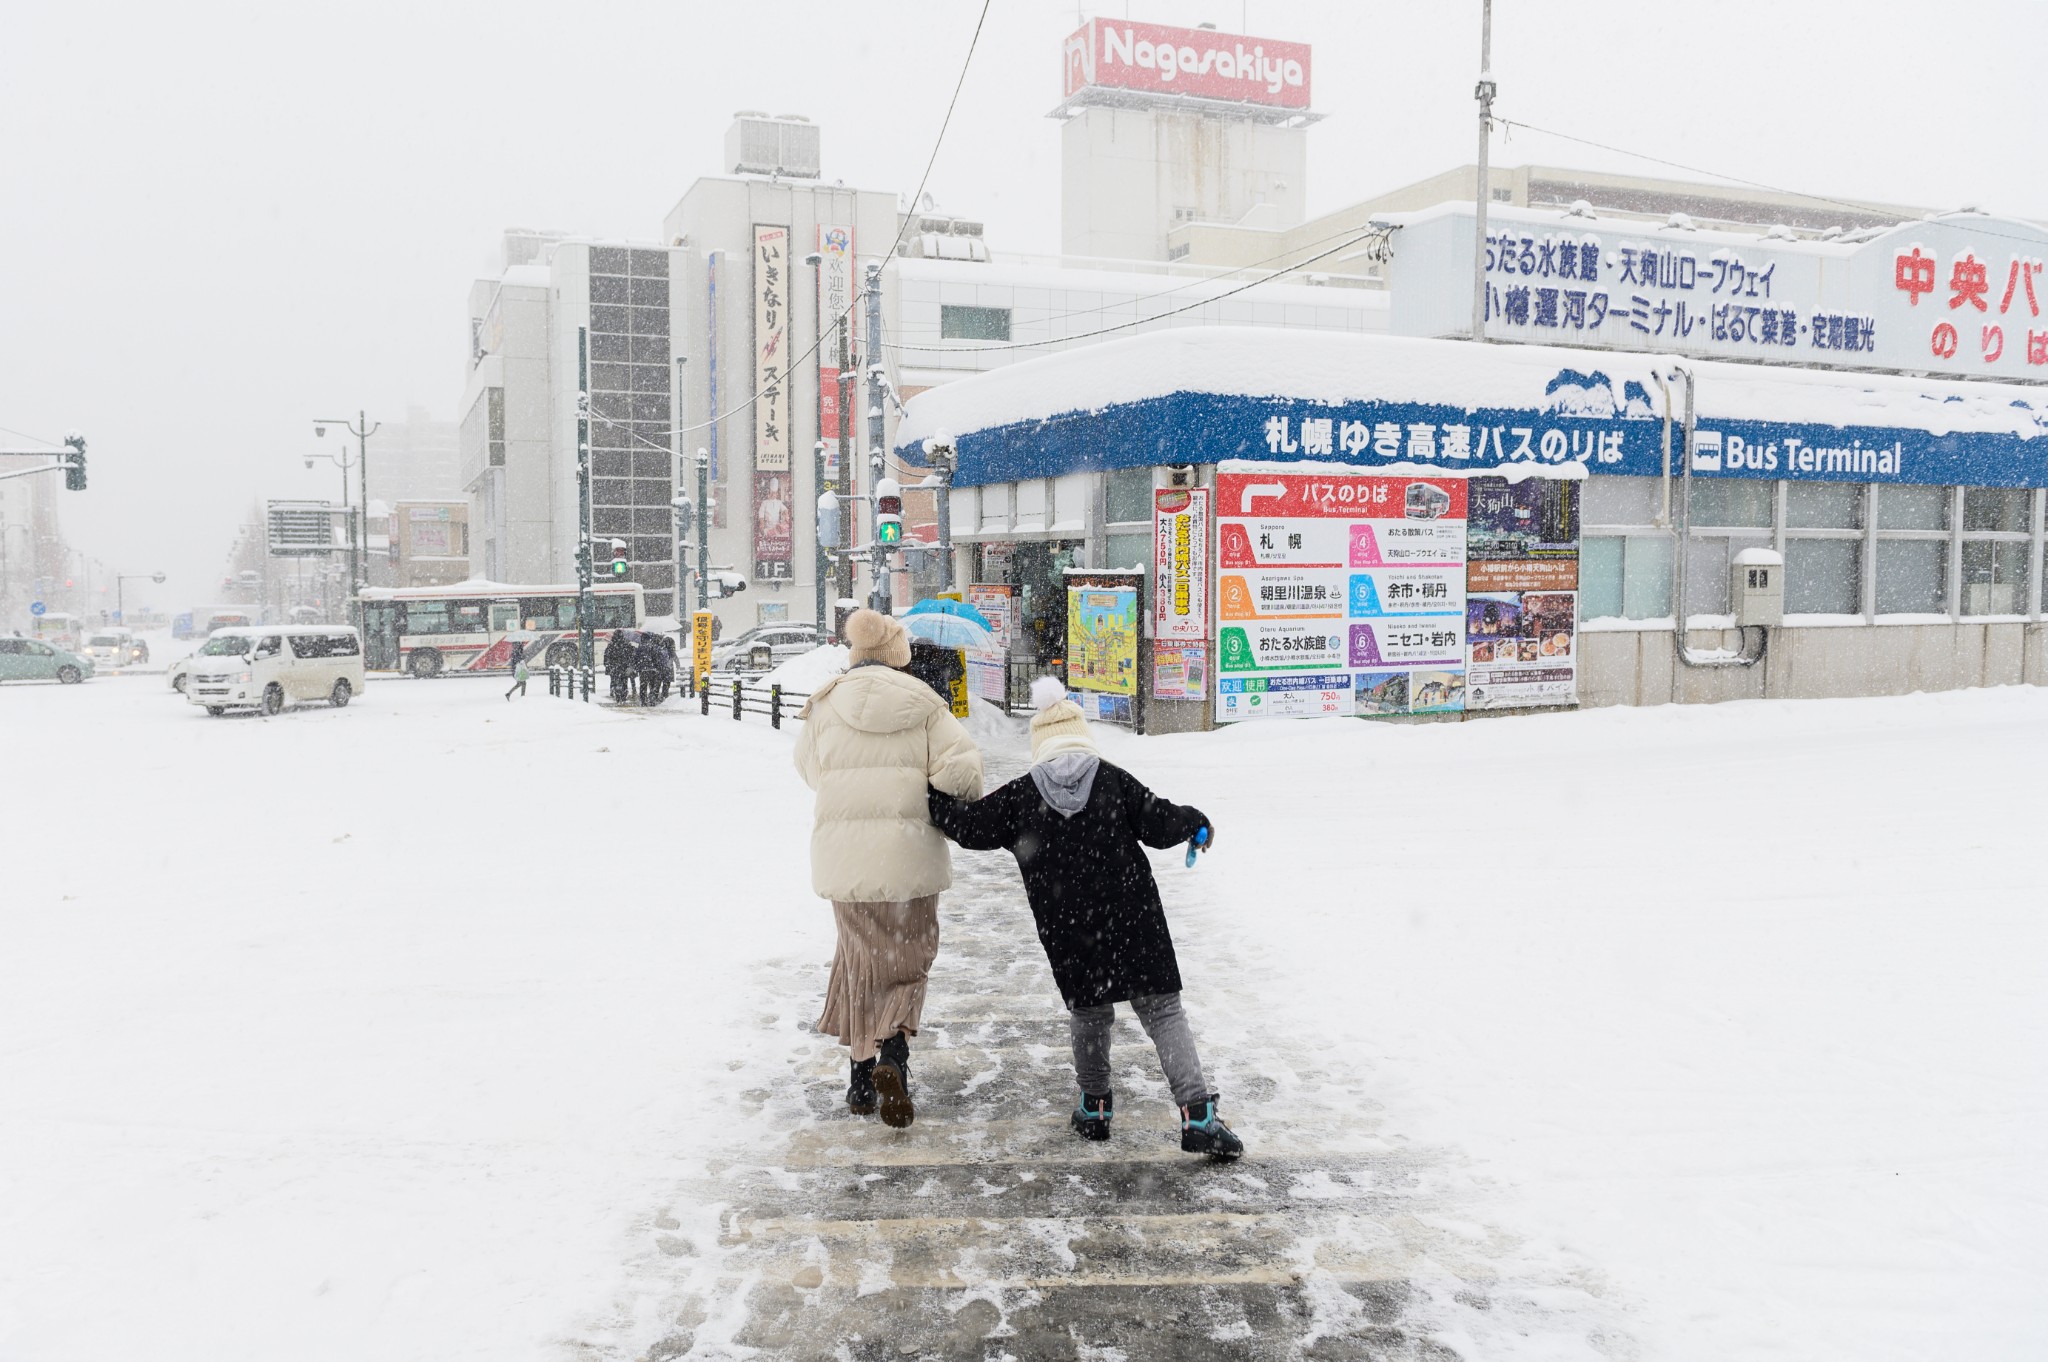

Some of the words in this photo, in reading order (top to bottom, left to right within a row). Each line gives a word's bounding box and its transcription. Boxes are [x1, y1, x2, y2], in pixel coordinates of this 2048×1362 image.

[1104, 27, 1303, 94] Nagasakiya
[761, 246, 782, 330] いきなり
[763, 366, 781, 442] ステーキ
[1265, 416, 1625, 464] 札幌ゆき高速バスのりば
[1726, 435, 1779, 470] Bus
[1784, 438, 1901, 473] Terminal
[1302, 483, 1388, 503] バスのりば
[1473, 493, 1514, 514] 天狗山
[1388, 528, 1434, 537] おたる散策バス
[1260, 533, 1302, 550] 札幌
[762, 562, 785, 577] 1F
[1260, 585, 1326, 600] 朝里川温泉
[1388, 583, 1447, 599] 余市・積丹
[1172, 625, 1200, 633] 中央バス
[1260, 635, 1326, 651] おたる水族館
[1387, 631, 1456, 647] ニセコ・岩内
